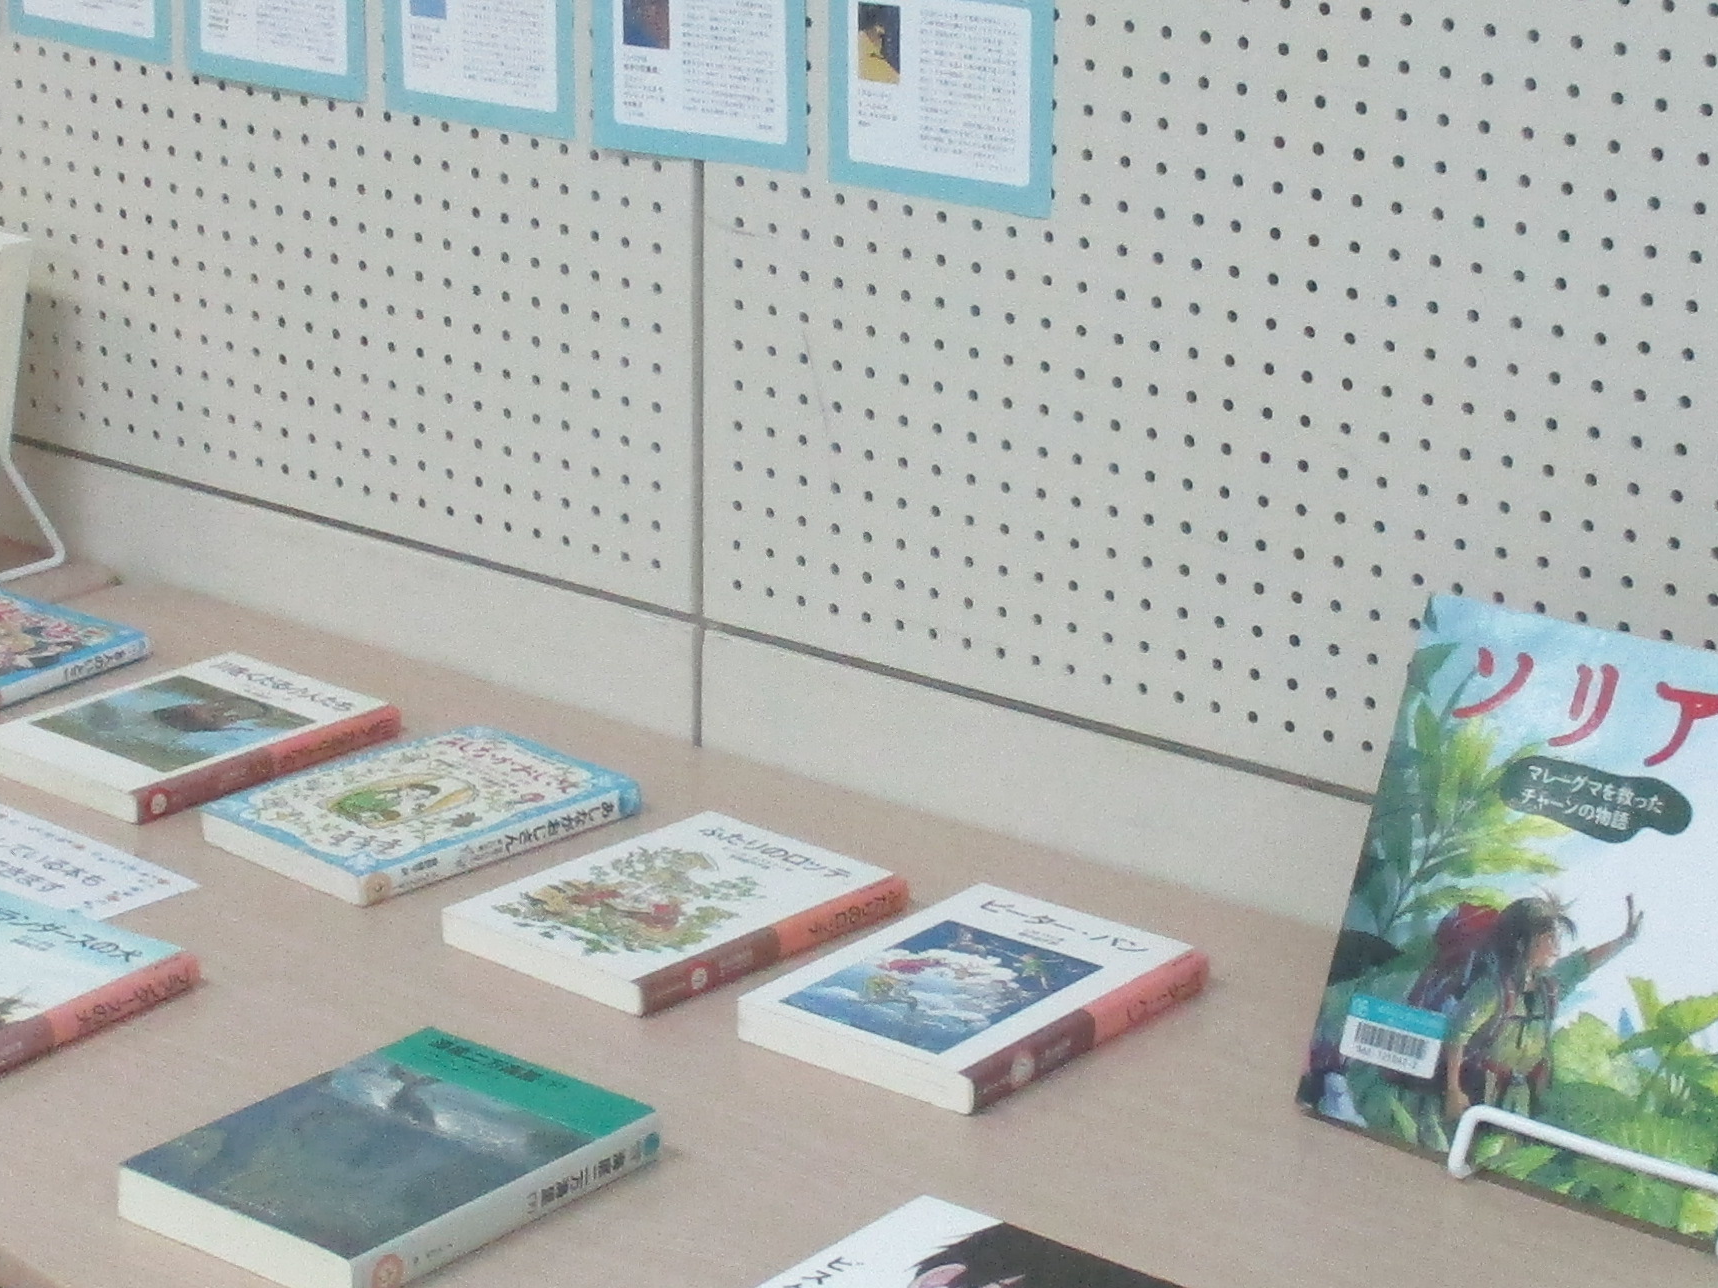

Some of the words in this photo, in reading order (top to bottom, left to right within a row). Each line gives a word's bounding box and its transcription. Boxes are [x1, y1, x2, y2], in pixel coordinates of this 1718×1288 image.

[1519, 787, 1631, 833] チャーンの物語
[1526, 763, 1665, 814] マレーグマを救った
[504, 800, 615, 854] あしながおじさん
[698, 825, 852, 879] ふたりのロッテ
[979, 899, 1151, 952] ピーター・パン
